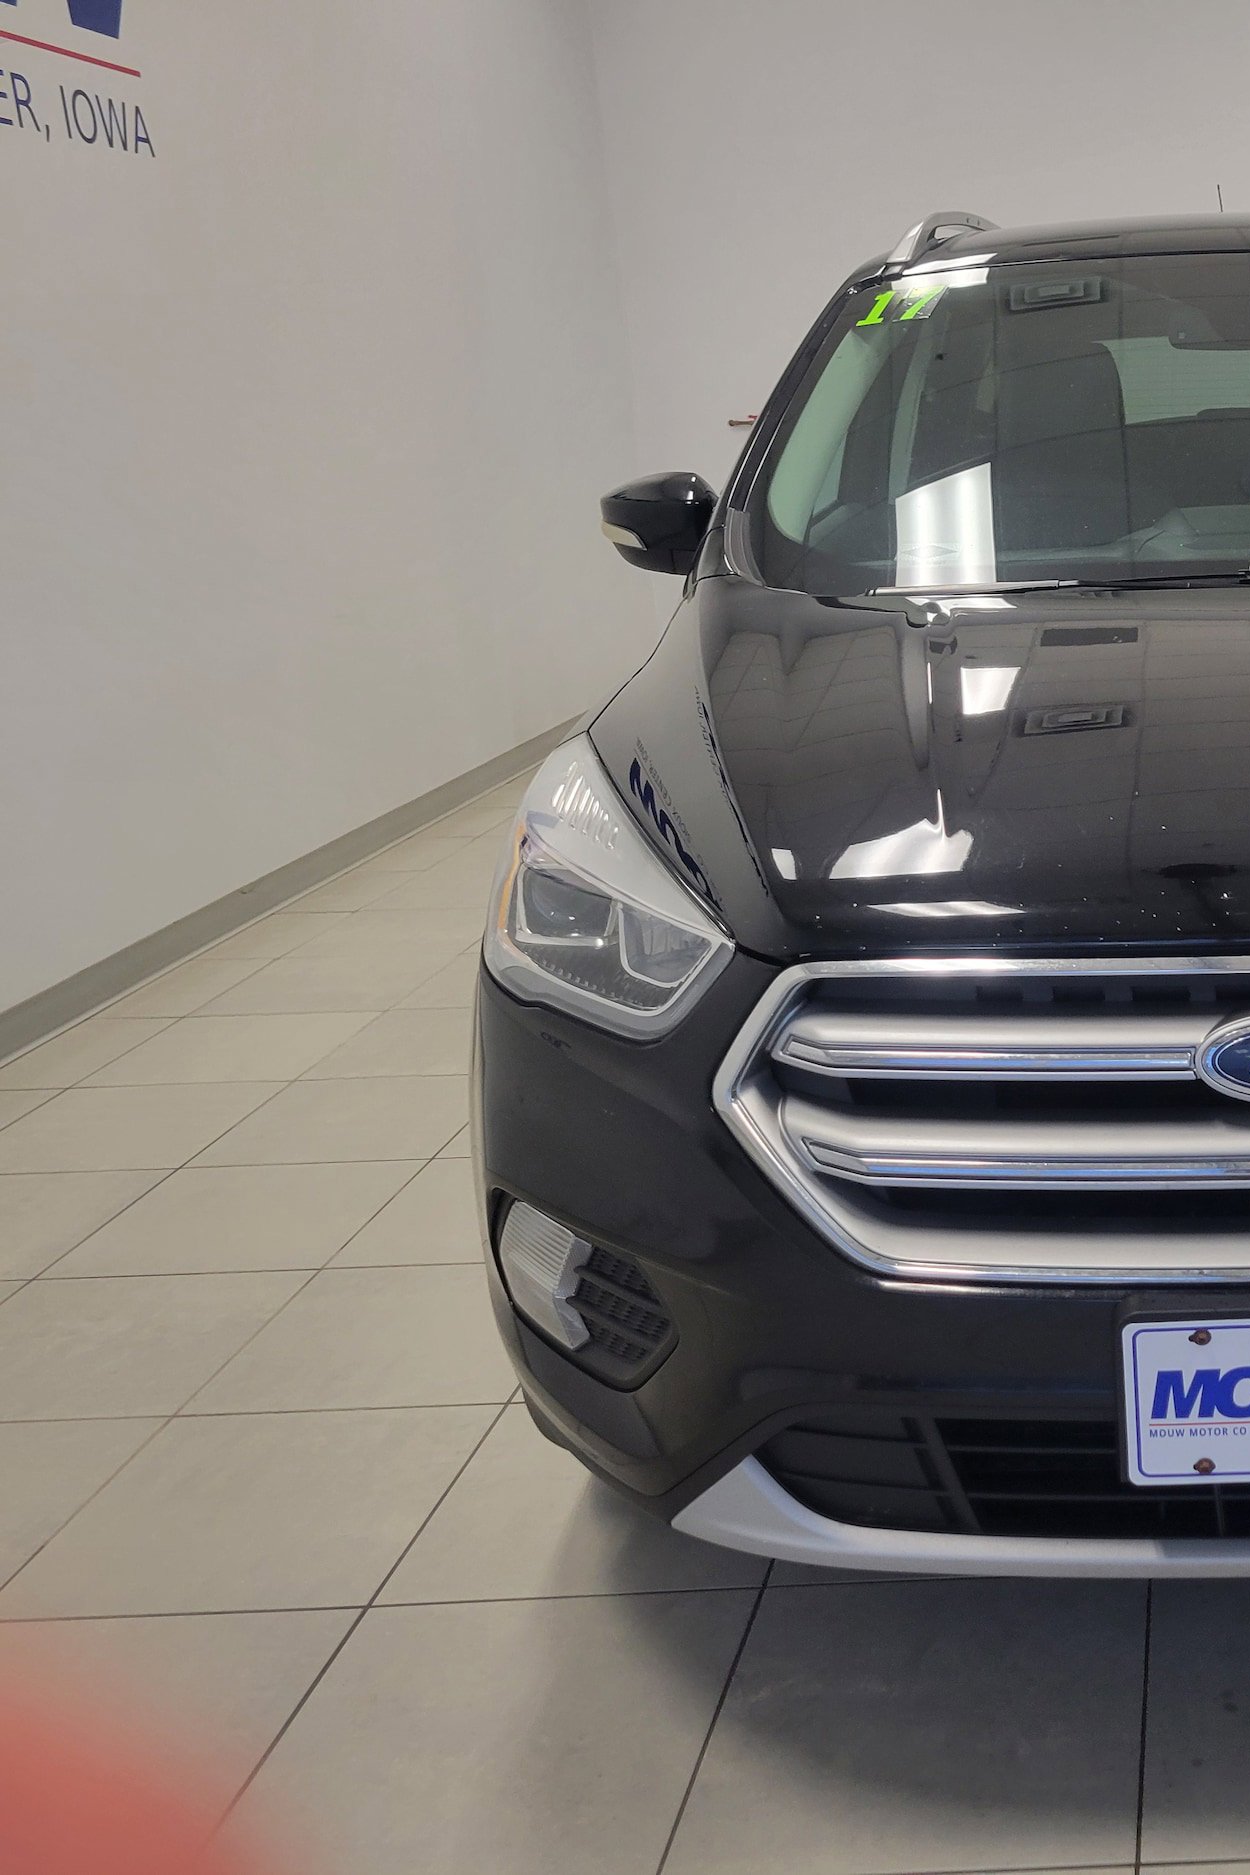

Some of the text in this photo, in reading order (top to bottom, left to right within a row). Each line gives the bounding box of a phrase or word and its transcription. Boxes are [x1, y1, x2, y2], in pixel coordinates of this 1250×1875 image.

[59, 85, 156, 158] IOWA
[1149, 1428, 1185, 1438] MOUW
[1189, 1427, 1228, 1437] MOTOR
[1233, 1426, 1248, 1436] CO
